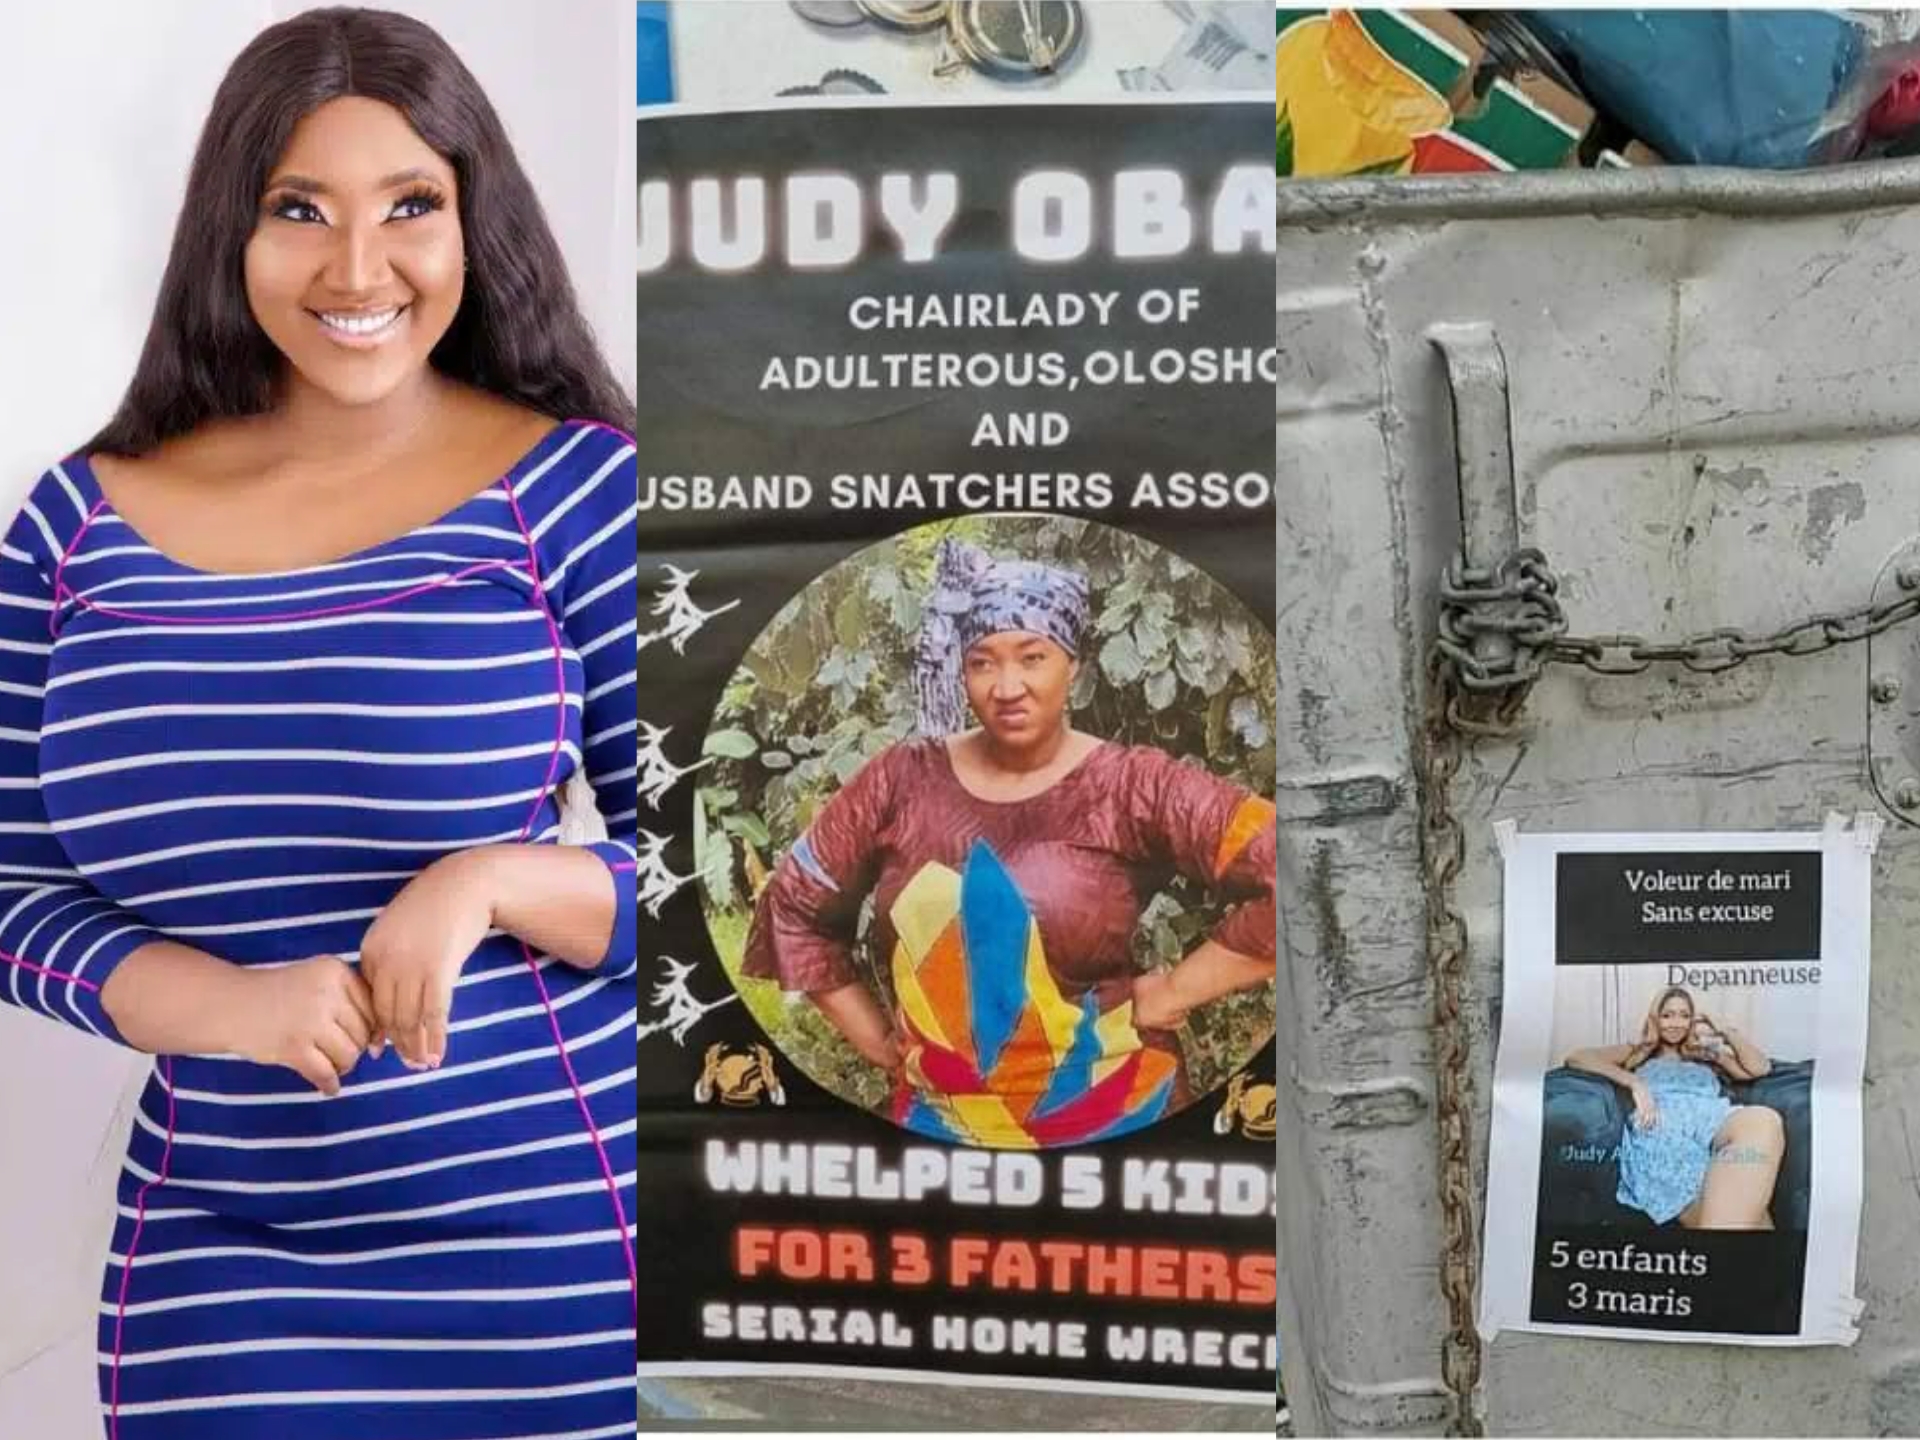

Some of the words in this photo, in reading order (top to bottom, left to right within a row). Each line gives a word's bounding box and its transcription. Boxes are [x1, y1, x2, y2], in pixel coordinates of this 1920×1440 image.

[848, 290, 1119, 330] CHAIRLADY
[1137, 288, 1200, 323] OF
[971, 411, 1070, 448] AND
[830, 471, 1113, 510] SNATCHERS
[1130, 470, 1276, 509] ASSO
[1624, 869, 1703, 892] Voleur
[1707, 869, 1735, 890] de
[1739, 869, 1792, 890] mari
[1641, 901, 1694, 923] Sans
[1698, 904, 1774, 922] excuse
[1666, 964, 1822, 991] Depanneuse
[704, 1140, 1043, 1206] WHELPED
[1061, 1154, 1104, 1209] 5
[1123, 1159, 1276, 1216] KID
[738, 1228, 875, 1282] FOR
[893, 1236, 930, 1283] 3
[951, 1238, 1276, 1305] FATHERS
[1549, 1240, 1570, 1268] 5
[1576, 1244, 1708, 1276] enfants
[1567, 1282, 1588, 1309] 3
[1594, 1288, 1693, 1316] maris
[702, 1303, 913, 1349] SERIAL
[932, 1315, 1087, 1360] HOME
